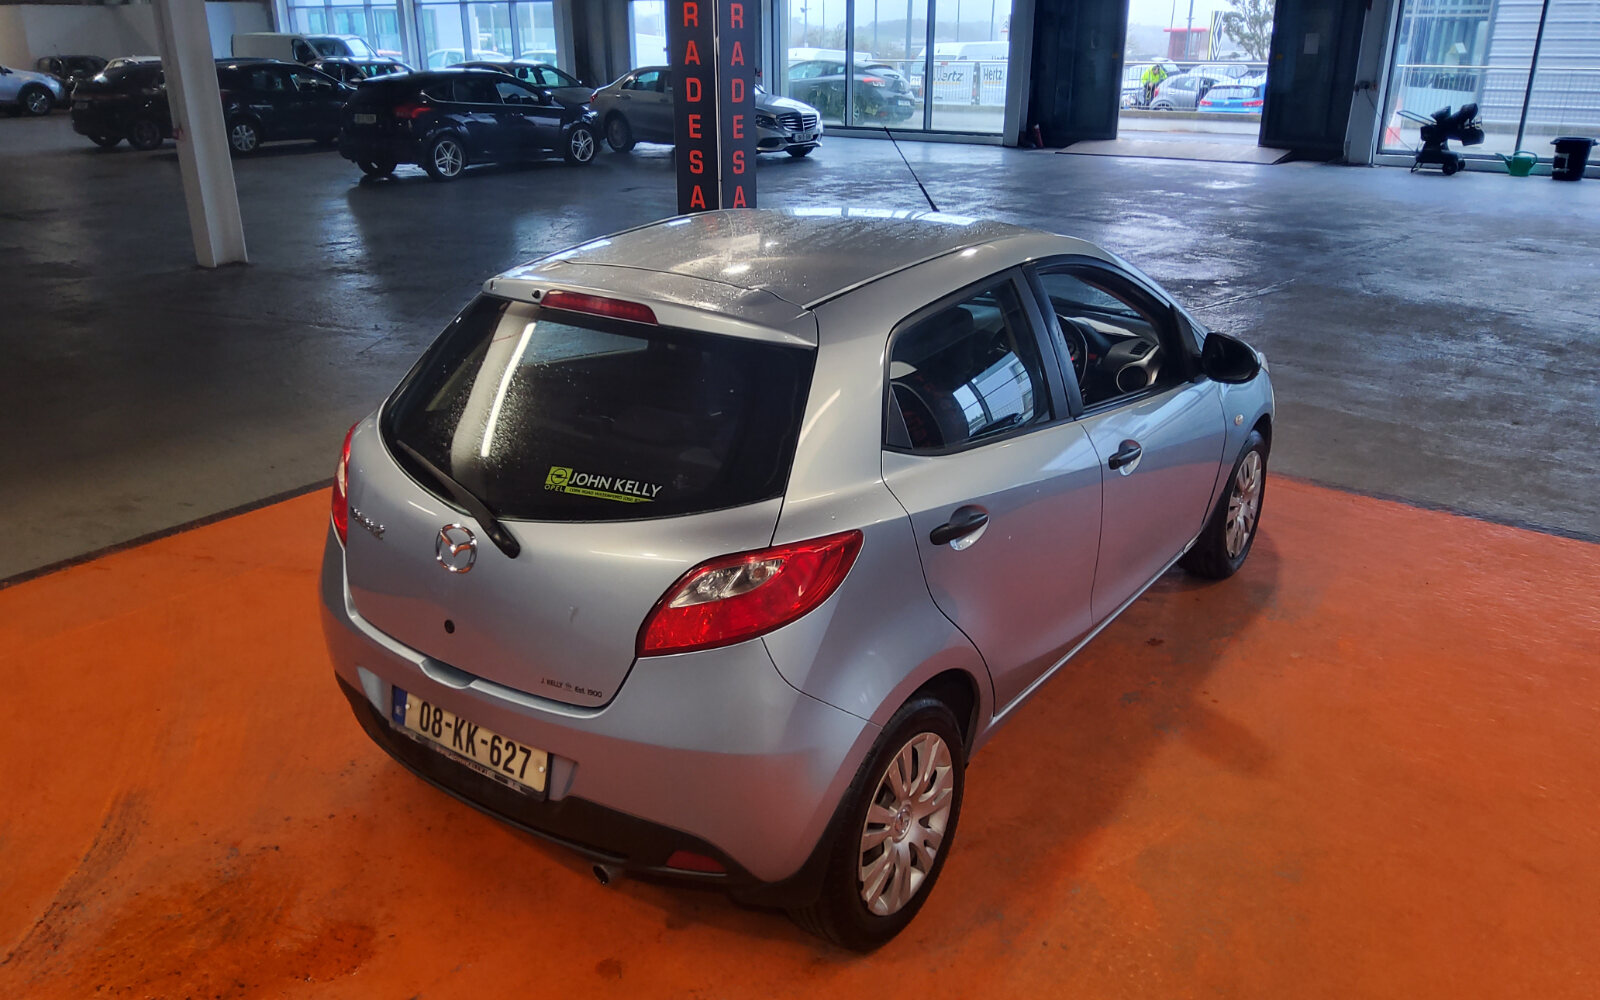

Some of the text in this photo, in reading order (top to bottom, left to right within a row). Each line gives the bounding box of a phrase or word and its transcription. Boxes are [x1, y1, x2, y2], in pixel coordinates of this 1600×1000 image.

[983, 67, 1003, 81] Hertz
[544, 484, 564, 493] OPEL
[569, 472, 663, 498] JOHN KELLY
[419, 701, 532, 780] 08-KK-627
